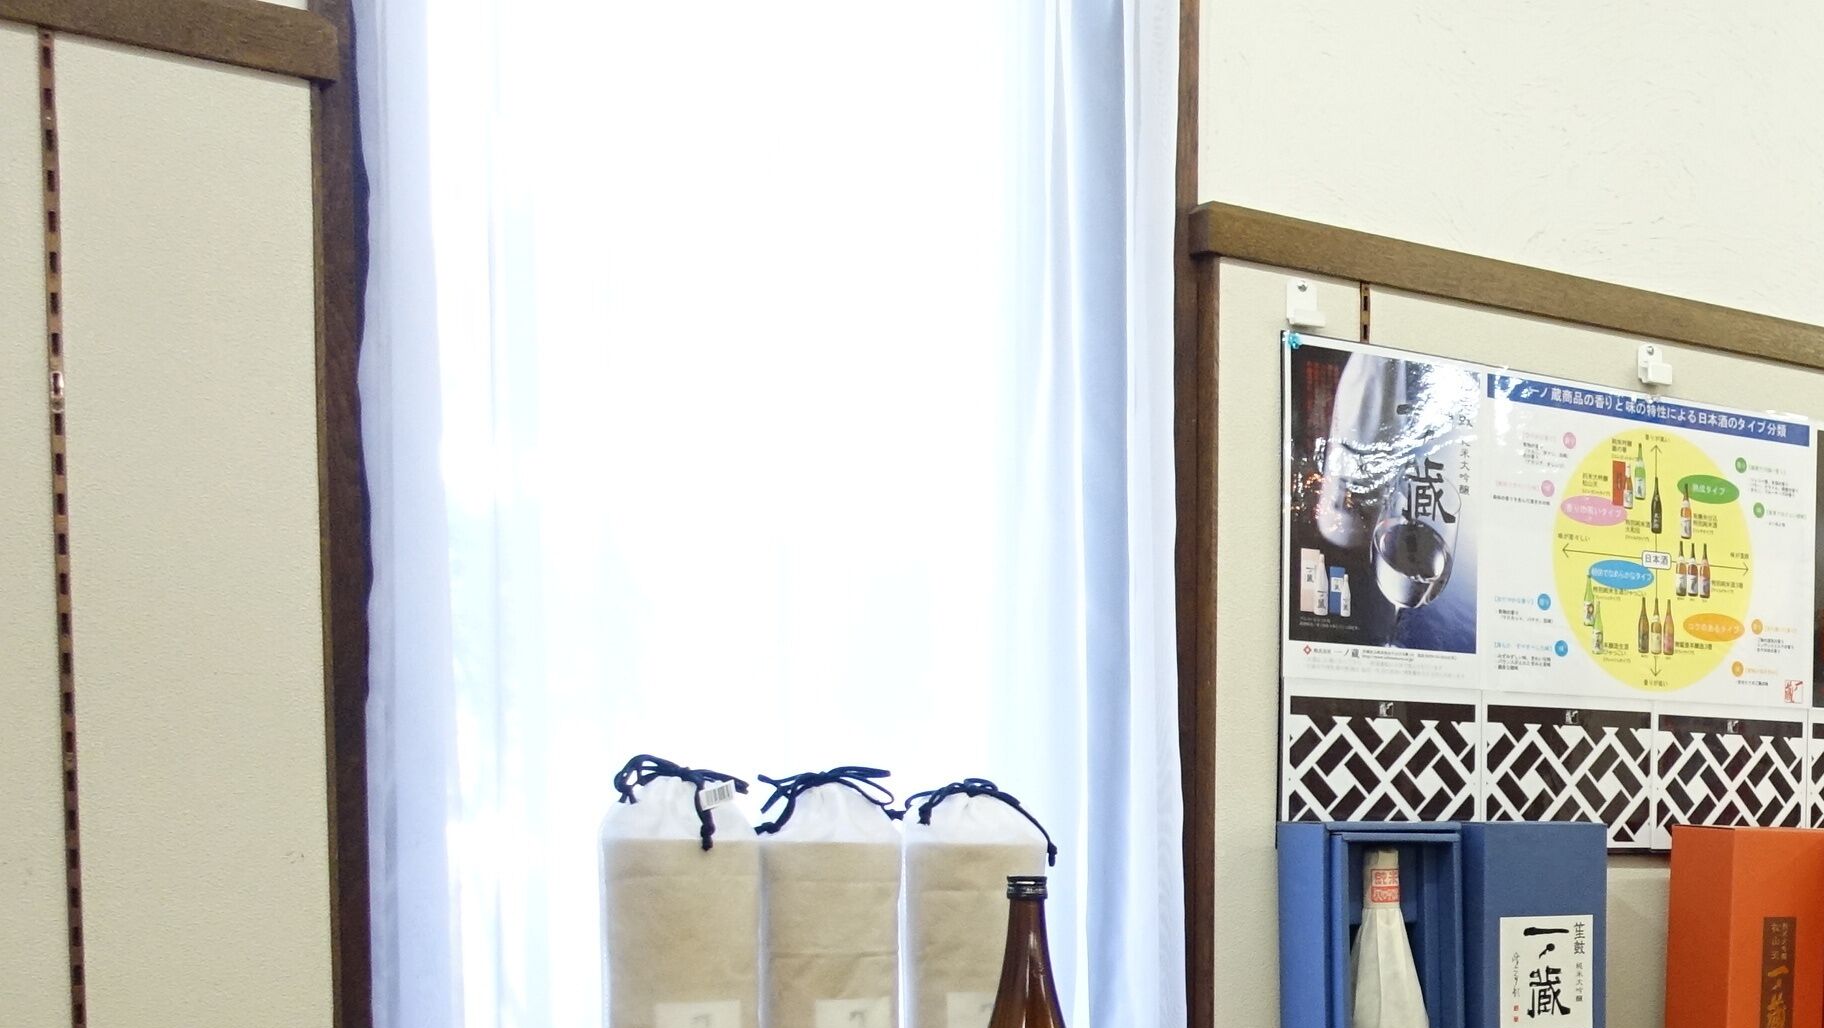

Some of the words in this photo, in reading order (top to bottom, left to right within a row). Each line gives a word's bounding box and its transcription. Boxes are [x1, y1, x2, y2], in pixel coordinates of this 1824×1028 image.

[1692, 483, 1726, 496] 熟成タイプ
[1645, 555, 1669, 566] 日本酒
[1523, 926, 1571, 1019] 一ノ蔵
